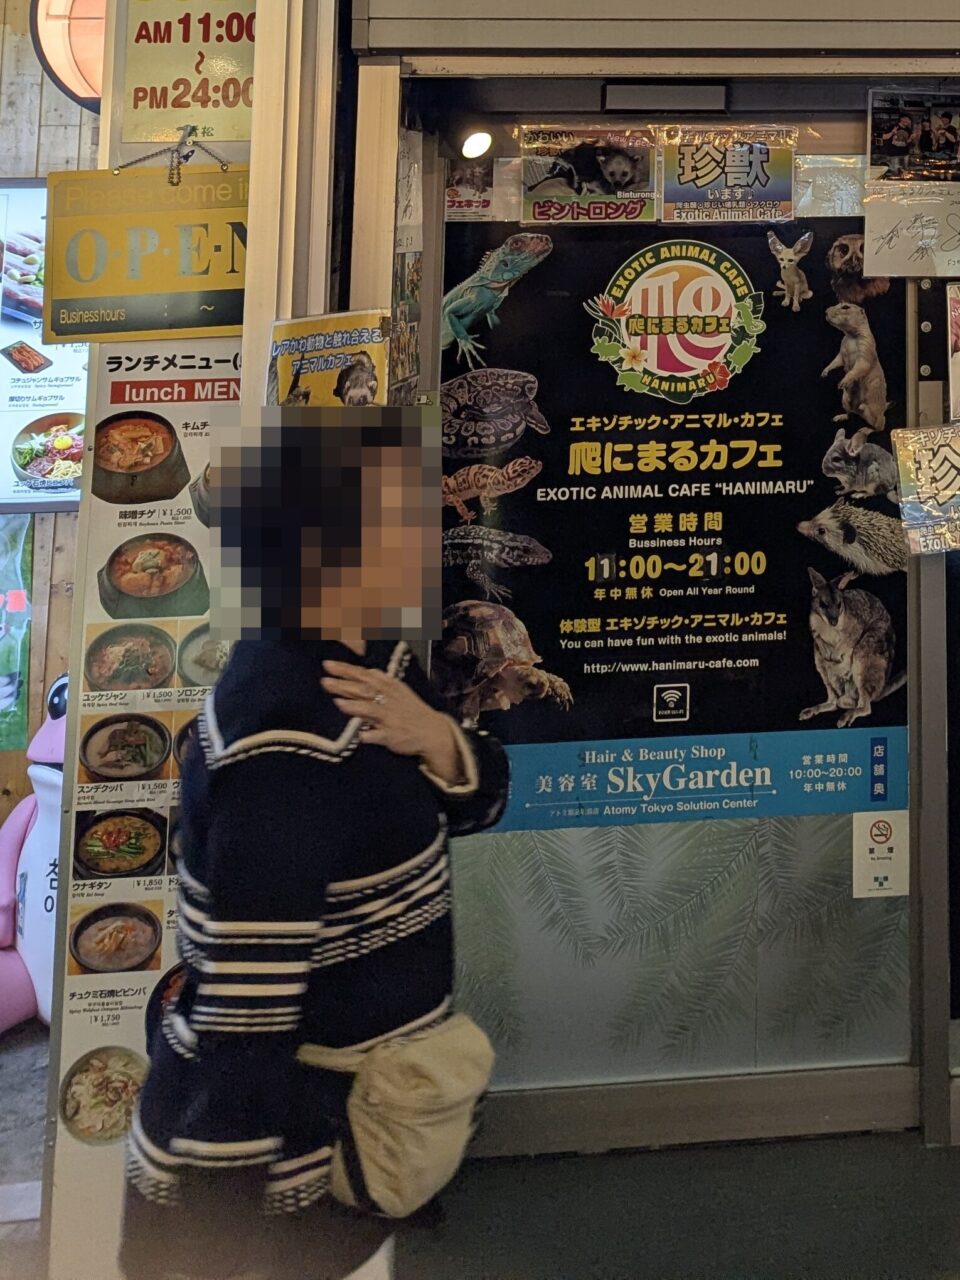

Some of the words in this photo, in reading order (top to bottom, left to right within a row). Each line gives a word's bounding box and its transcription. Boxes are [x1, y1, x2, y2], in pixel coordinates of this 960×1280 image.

[134, 21, 172, 43] AM
[133, 86, 169, 109] PM
[677, 141, 770, 189] 珍獣
[66, 186, 150, 210] Please
[162, 182, 232, 205] come
[617, 191, 655, 200] Binturong
[533, 200, 646, 220] ビントロング
[673, 210, 705, 221] Exotic
[711, 210, 755, 220] Animal
[757, 209, 782, 220] Cafe
[611, 252, 656, 298] EXOTIC
[660, 245, 718, 265] ANIMAL
[719, 261, 749, 297] CAFE
[60, 310, 99, 324] Business
[100, 308, 126, 322] hours
[628, 317, 731, 334] 爬にまるカフェ
[641, 373, 716, 392] HANIMARU
[124, 384, 186, 402] lunch
[570, 413, 783, 432] エキゾチック・アニマル・カフェ
[568, 439, 783, 476] 爬にまるカフェ
[536, 486, 597, 502] EXOTIC
[601, 485, 664, 500] ANIMAL
[668, 483, 711, 498] CAFE
[629, 512, 723, 534] 営業時間
[689, 536, 723, 547] Hours
[594, 587, 653, 601] 年中無休
[659, 588, 684, 599] Open
[686, 586, 699, 596] All
[702, 586, 723, 596] Year
[725, 584, 755, 595] Round
[560, 619, 601, 634] 体験型
[605, 612, 787, 632] エキゾチック・アニマル・カフェ
[560, 638, 581, 649] You
[584, 639, 603, 648] can
[607, 636, 633, 647] have
[636, 635, 655, 646] fun
[658, 634, 682, 645] with
[685, 633, 702, 644] the
[705, 632, 739, 643] exotic
[742, 630, 787, 642] animals!
[583, 656, 759, 674] http://www.hanimaru-cafe.com
[83, 692, 127, 701] ユッケジャン
[585, 751, 617, 764] Hair
[621, 749, 634, 762] &
[639, 747, 687, 762] Beauty
[691, 745, 726, 761] Shop
[536, 773, 598, 794] 美容室
[606, 762, 772, 801] SkyGarden
[603, 805, 637, 816] Atomy
[640, 802, 674, 814] Tokyo
[676, 800, 721, 812] Solution
[722, 798, 758, 810] Center
[72, 881, 112, 891] ウナギタン
